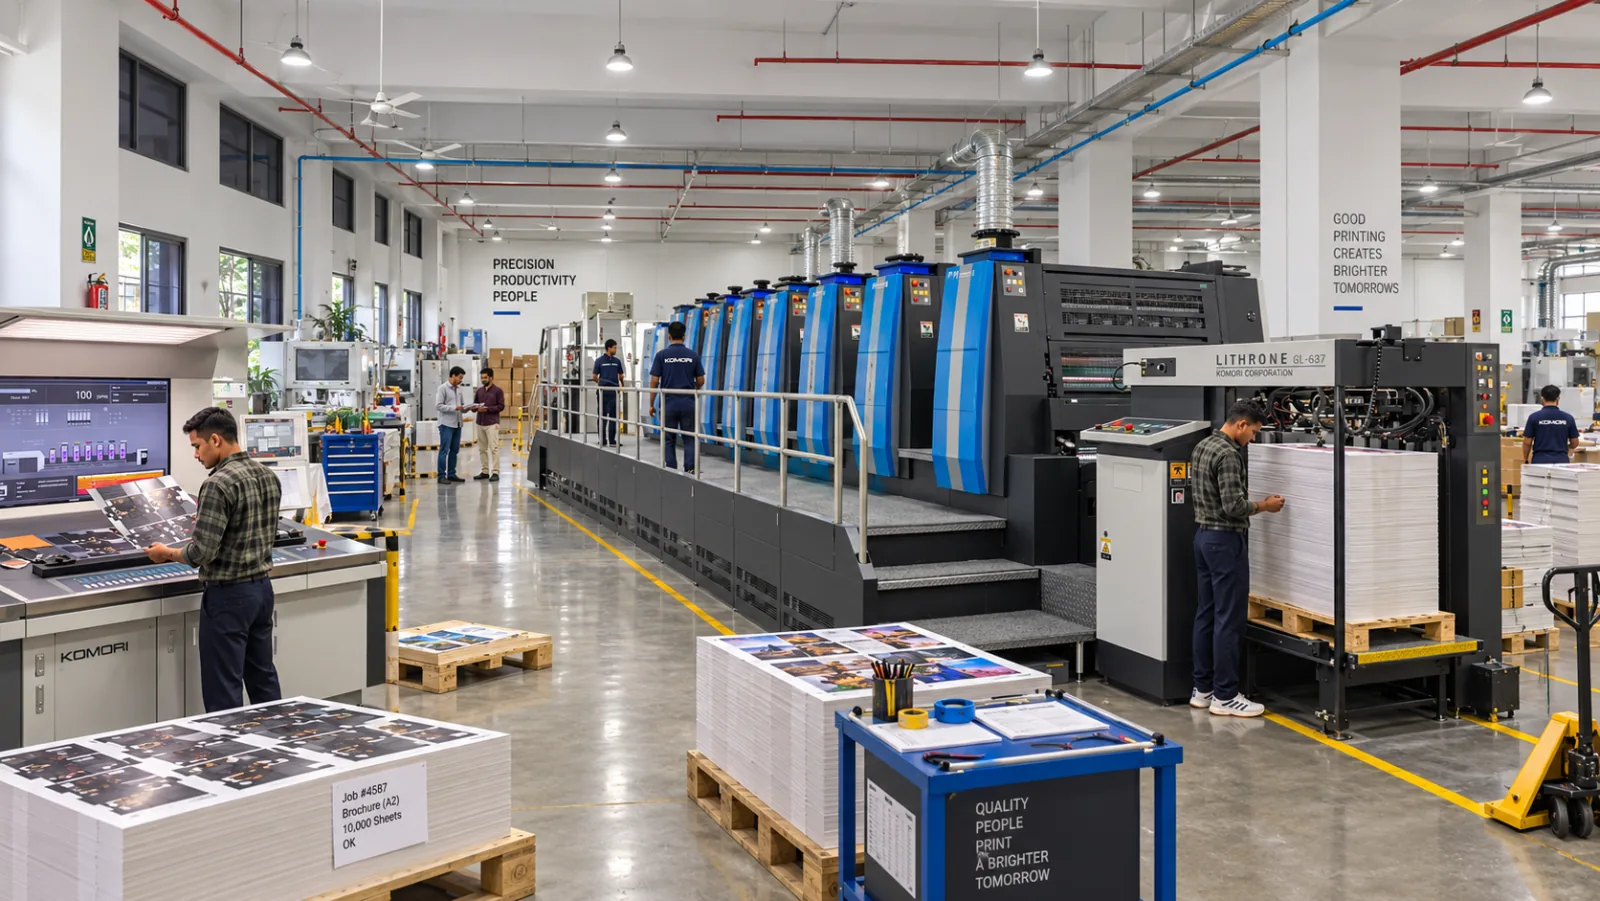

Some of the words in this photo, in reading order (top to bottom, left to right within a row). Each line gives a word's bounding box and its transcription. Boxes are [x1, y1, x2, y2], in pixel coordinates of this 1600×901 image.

[1333, 212, 1366, 225] GOOD
[1333, 230, 1386, 242] PRINTING
[1333, 247, 1383, 260] CREATES
[493, 258, 555, 270] PRECISION
[1333, 265, 1388, 277] BRIGHTER
[493, 274, 577, 286] PRODUCTIVITY
[1333, 282, 1399, 294] TOMORROWS
[493, 290, 538, 302] PEOPLE
[1216, 352, 1288, 366] LITHRONE
[1292, 354, 1326, 365] GL-637
[1244, 368, 1293, 377] CORPORATION
[75, 390, 93, 400] 100
[61, 641, 129, 663] KOMORI
[342, 790, 359, 804] Job
[342, 801, 381, 819] Brochure
[382, 795, 400, 810] (A2)
[975, 796, 1029, 816] QUALITY
[342, 817, 372, 834] 10,000
[373, 811, 402, 827] Sheets
[975, 815, 1024, 834] PEOPLE
[342, 837, 356, 850] OK
[975, 835, 1013, 854] PRINT
[975, 856, 985, 871] A
[987, 849, 1049, 870] BRIGHTER
[975, 868, 1051, 890] TOMORROW
